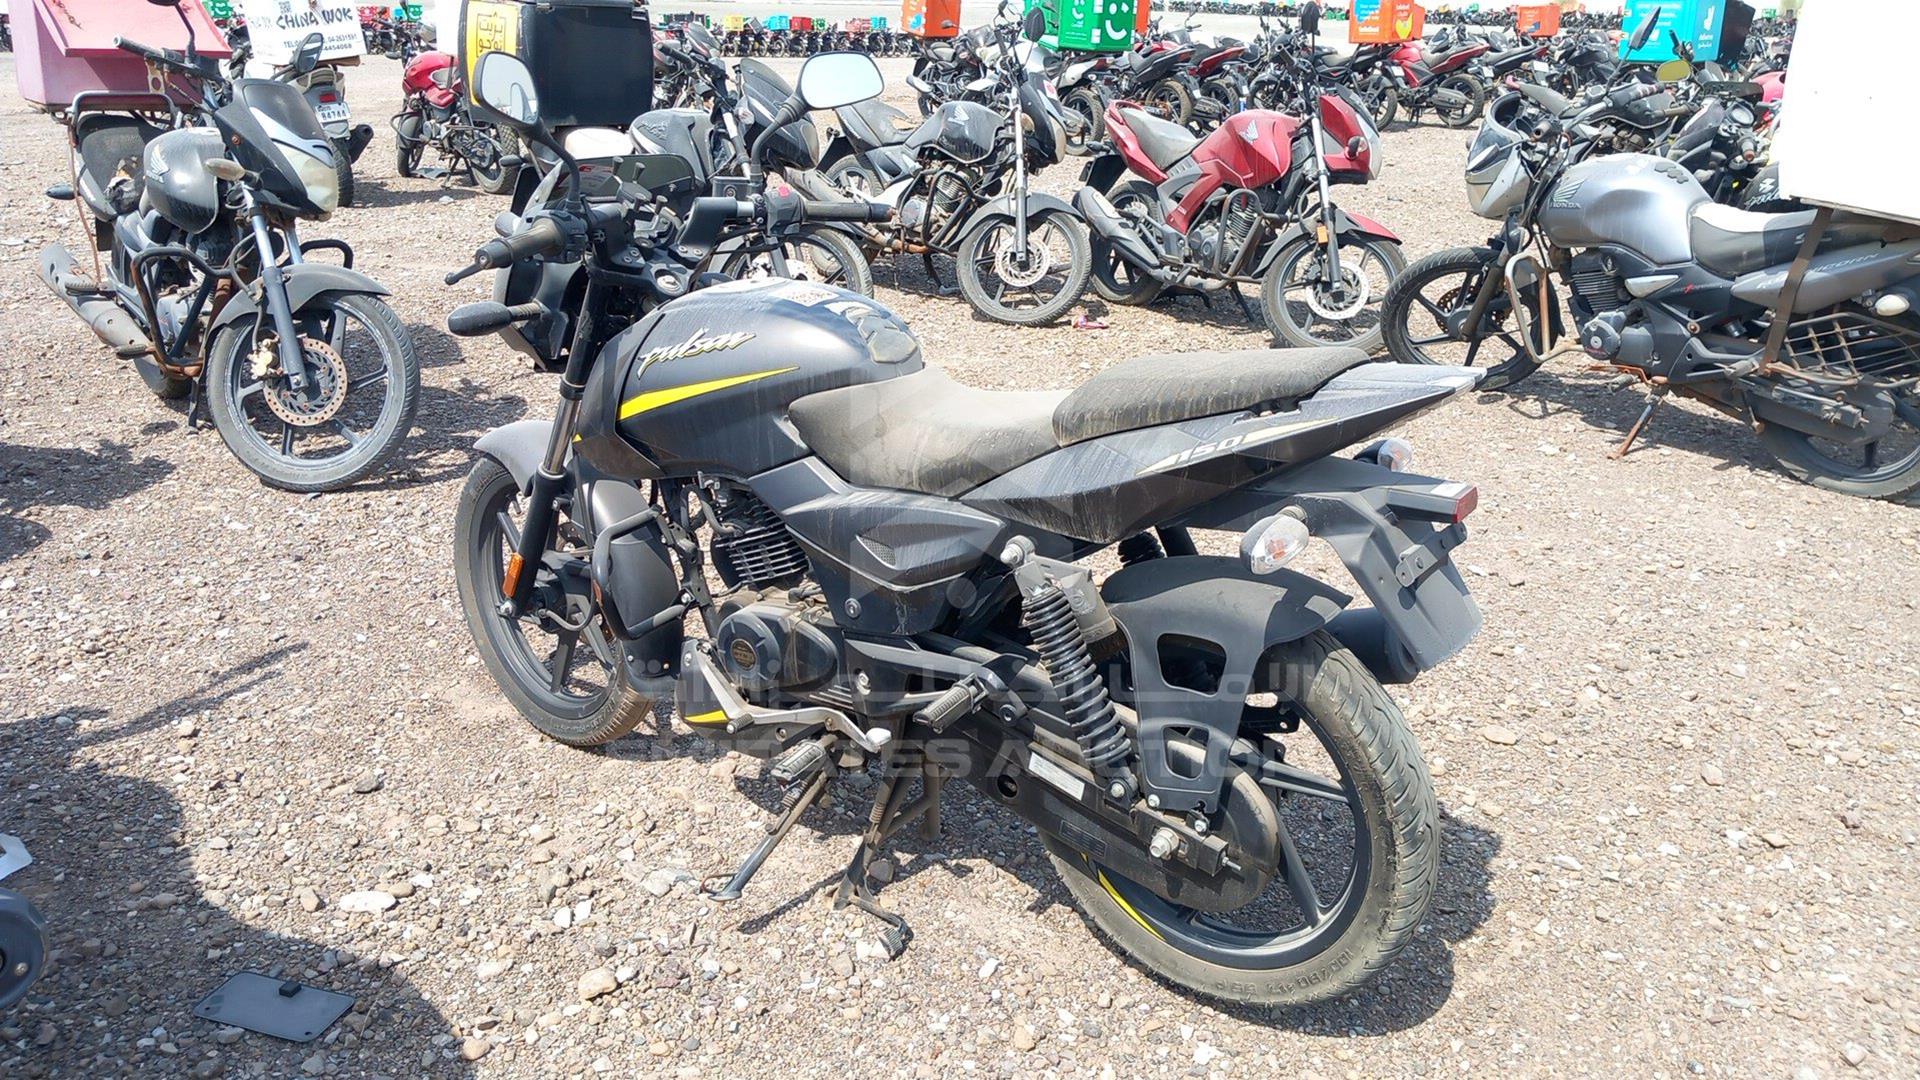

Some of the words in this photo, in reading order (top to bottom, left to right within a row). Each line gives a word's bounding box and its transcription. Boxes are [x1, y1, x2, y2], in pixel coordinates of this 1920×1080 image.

[276, 11, 320, 30] CHINA
[321, 7, 353, 24] WOK
[1176, 435, 1243, 466] 150
